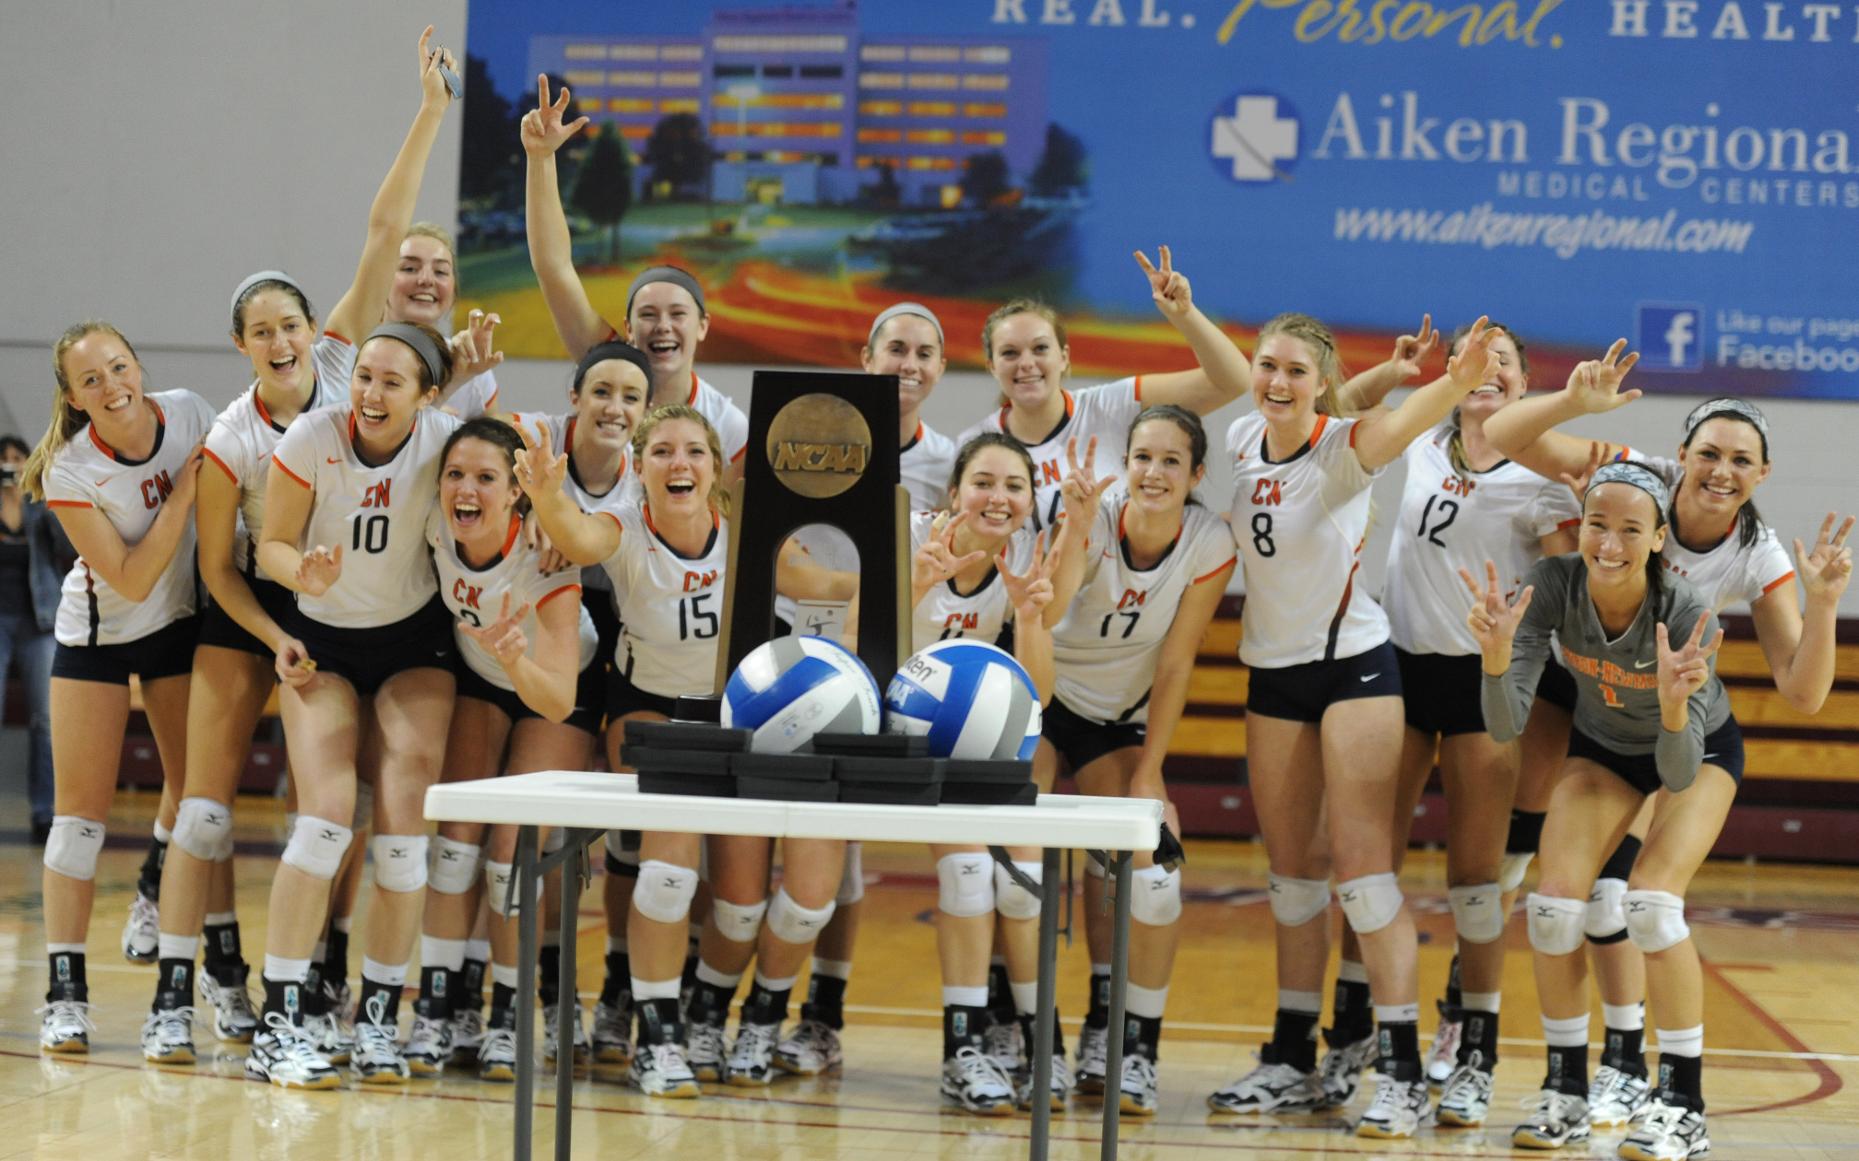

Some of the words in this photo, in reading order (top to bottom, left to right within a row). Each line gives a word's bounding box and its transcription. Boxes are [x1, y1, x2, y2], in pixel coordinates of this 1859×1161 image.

[990, 0, 1196, 29] REAL.
[1608, 0, 1859, 43] HEALT
[1311, 91, 1529, 163] Aiken
[1557, 97, 1859, 189] Regiona
[1500, 170, 1649, 201] MEDICAL
[1702, 177, 1859, 208] CENTERS
[1333, 201, 1755, 259] www.aikenregional.com
[1717, 309, 1762, 333] Like
[1767, 315, 1804, 335] our
[773, 441, 867, 475] NCAA
[141, 469, 174, 509] CN
[360, 477, 391, 508] CN
[1251, 478, 1287, 506] CN
[352, 514, 390, 554] 10
[1251, 512, 1277, 558] 8
[1417, 493, 1460, 549] 12
[453, 577, 484, 610] CN
[679, 593, 719, 641] 15
[1099, 611, 1141, 639] 17
